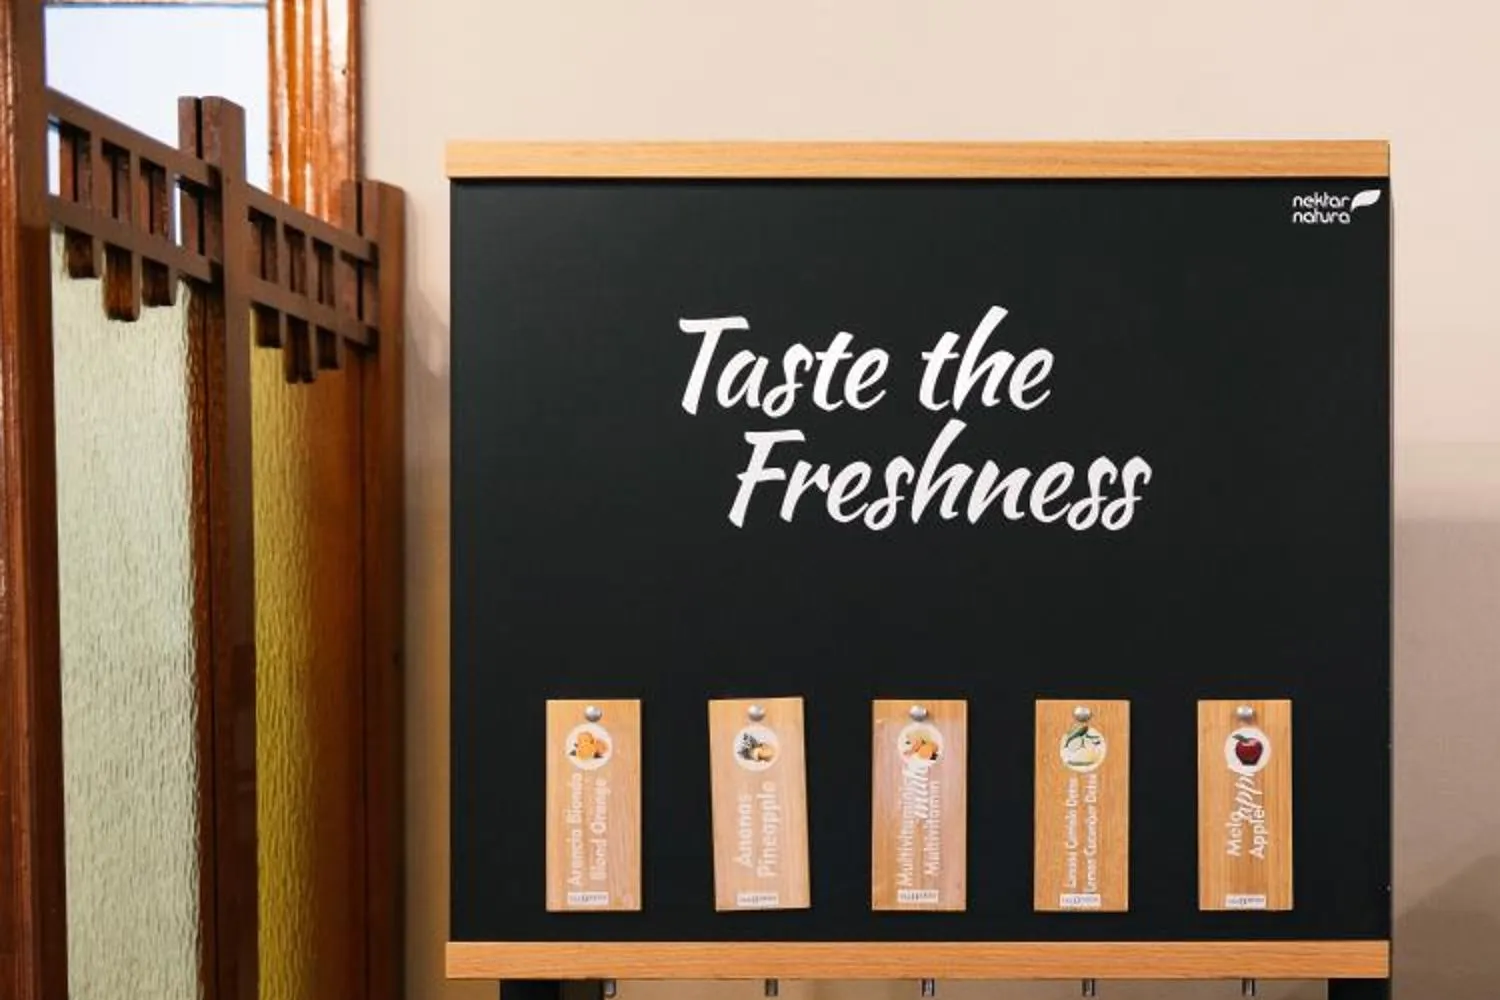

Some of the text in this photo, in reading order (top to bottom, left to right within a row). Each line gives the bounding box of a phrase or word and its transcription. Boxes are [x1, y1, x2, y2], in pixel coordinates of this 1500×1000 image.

[1292, 191, 1351, 208] nektar
[1292, 208, 1351, 224] natura
[679, 305, 1054, 418] Taste the
[728, 418, 1153, 531] Freshness
[733, 793, 753, 867] Ananas
[756, 780, 781, 877] Pineapple
